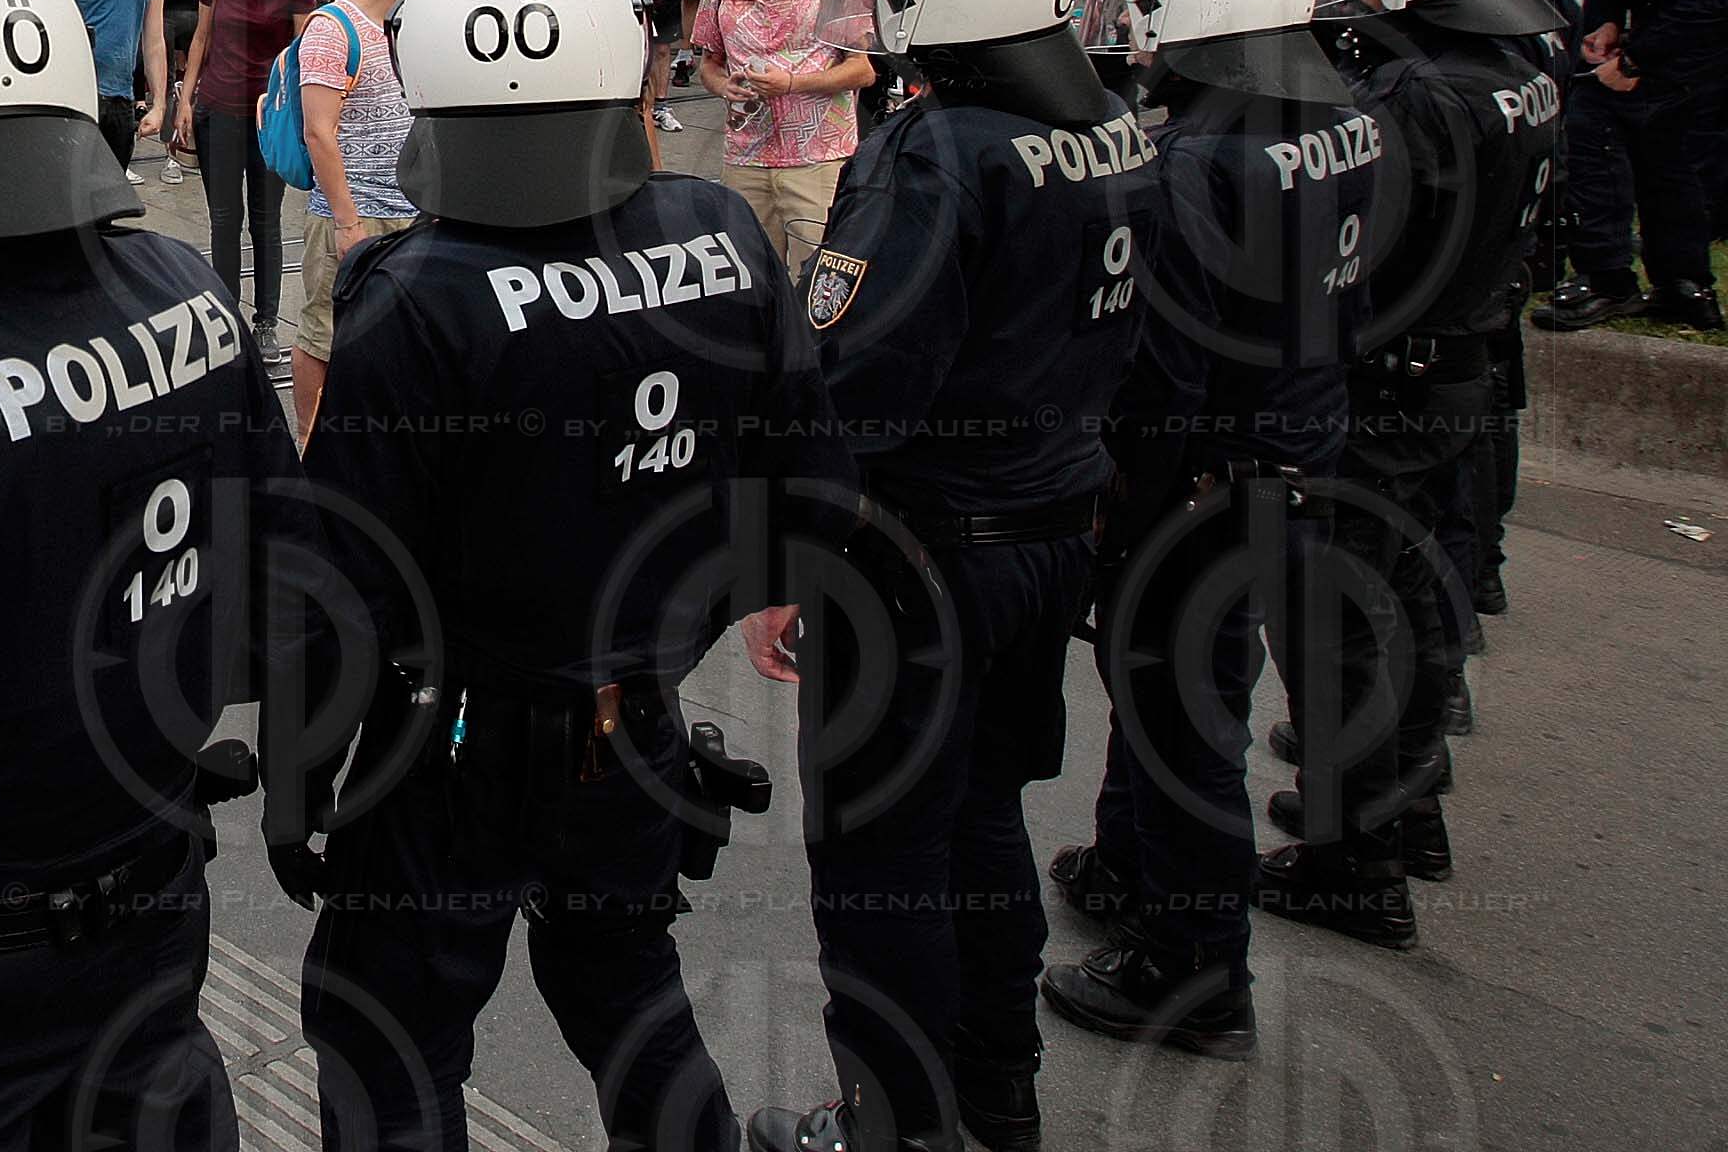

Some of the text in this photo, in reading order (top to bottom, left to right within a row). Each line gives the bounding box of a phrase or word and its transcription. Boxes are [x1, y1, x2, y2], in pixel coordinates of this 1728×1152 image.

[487, 231, 753, 333] POLIZEI
[820, 254, 860, 277] POLIZEI
[1089, 277, 1134, 320] 140
[614, 428, 696, 483] 140
[123, 548, 198, 622] 140
